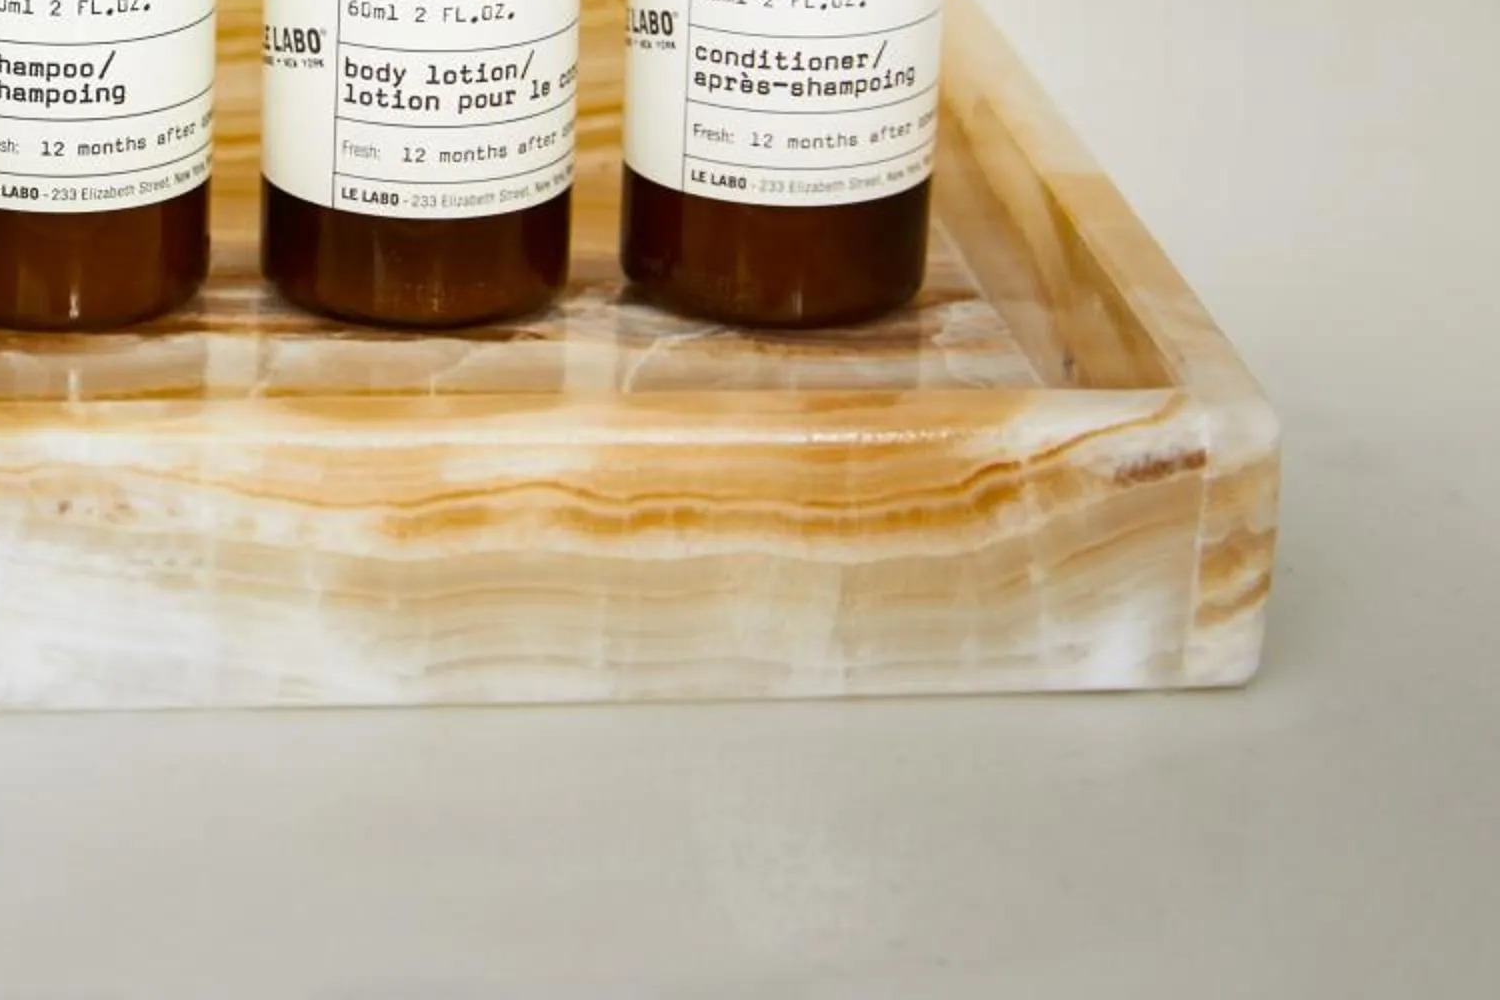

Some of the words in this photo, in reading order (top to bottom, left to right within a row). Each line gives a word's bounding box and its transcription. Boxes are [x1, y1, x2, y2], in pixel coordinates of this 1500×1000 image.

[49, 0, 62, 17] 2
[347, 0, 400, 21] 60ml
[414, 6, 428, 24] 2
[344, 57, 407, 87] body
[425, 50, 535, 85] lotion/
[694, 40, 888, 71] conditioner/
[343, 84, 440, 111] lotion
[457, 88, 517, 115] pour
[530, 79, 551, 100] le
[693, 65, 916, 99] après-shampoing
[41, 139, 66, 157] 12
[77, 132, 147, 157] months
[157, 121, 197, 146] after
[342, 139, 381, 159] Fresh:
[403, 146, 427, 163] 12
[439, 139, 508, 164] months
[517, 130, 557, 155] after
[693, 122, 735, 144] Fresh:
[750, 131, 773, 149] 12
[787, 126, 858, 150] months
[869, 119, 912, 144] after
[1, 184, 39, 200] LABO
[51, 187, 77, 201] 233
[81, 184, 136, 201] Elizabeth
[691, 169, 708, 183] LE
[710, 172, 747, 189] LABO
[341, 186, 359, 201] LE
[361, 189, 399, 206] LABO
[411, 193, 437, 208] 233
